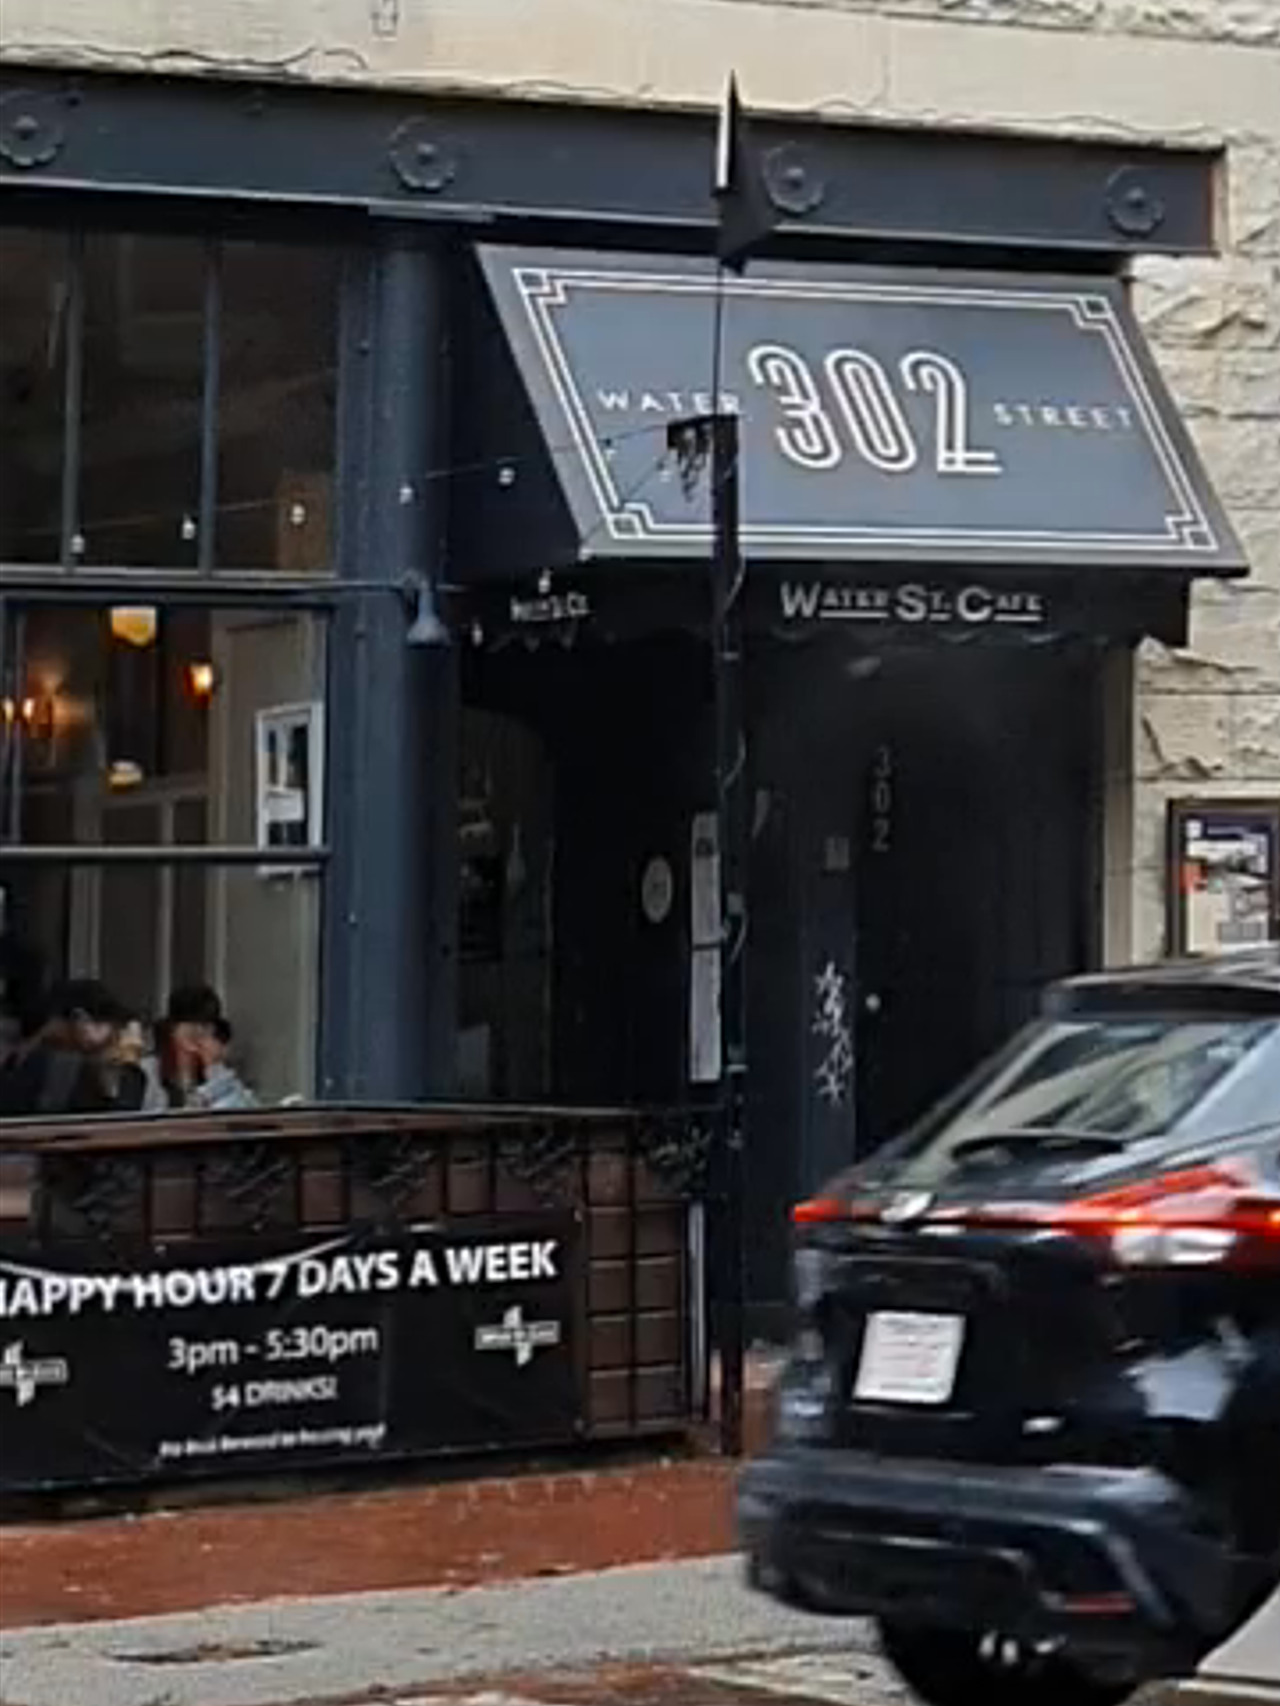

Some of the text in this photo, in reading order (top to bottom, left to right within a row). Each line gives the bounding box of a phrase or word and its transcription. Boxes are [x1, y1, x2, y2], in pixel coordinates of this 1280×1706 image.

[601, 387, 745, 417] WATER
[747, 344, 1002, 475] 302
[993, 403, 1133, 430] STREET
[131, 1266, 255, 1308] HOUR
[255, 1264, 287, 1300] 7
[298, 1250, 398, 1296] DAYS
[408, 1250, 438, 1286] A
[446, 1241, 558, 1284] WEEK
[168, 1337, 239, 1375] 3pm
[266, 1326, 378, 1362] 5:30pm
